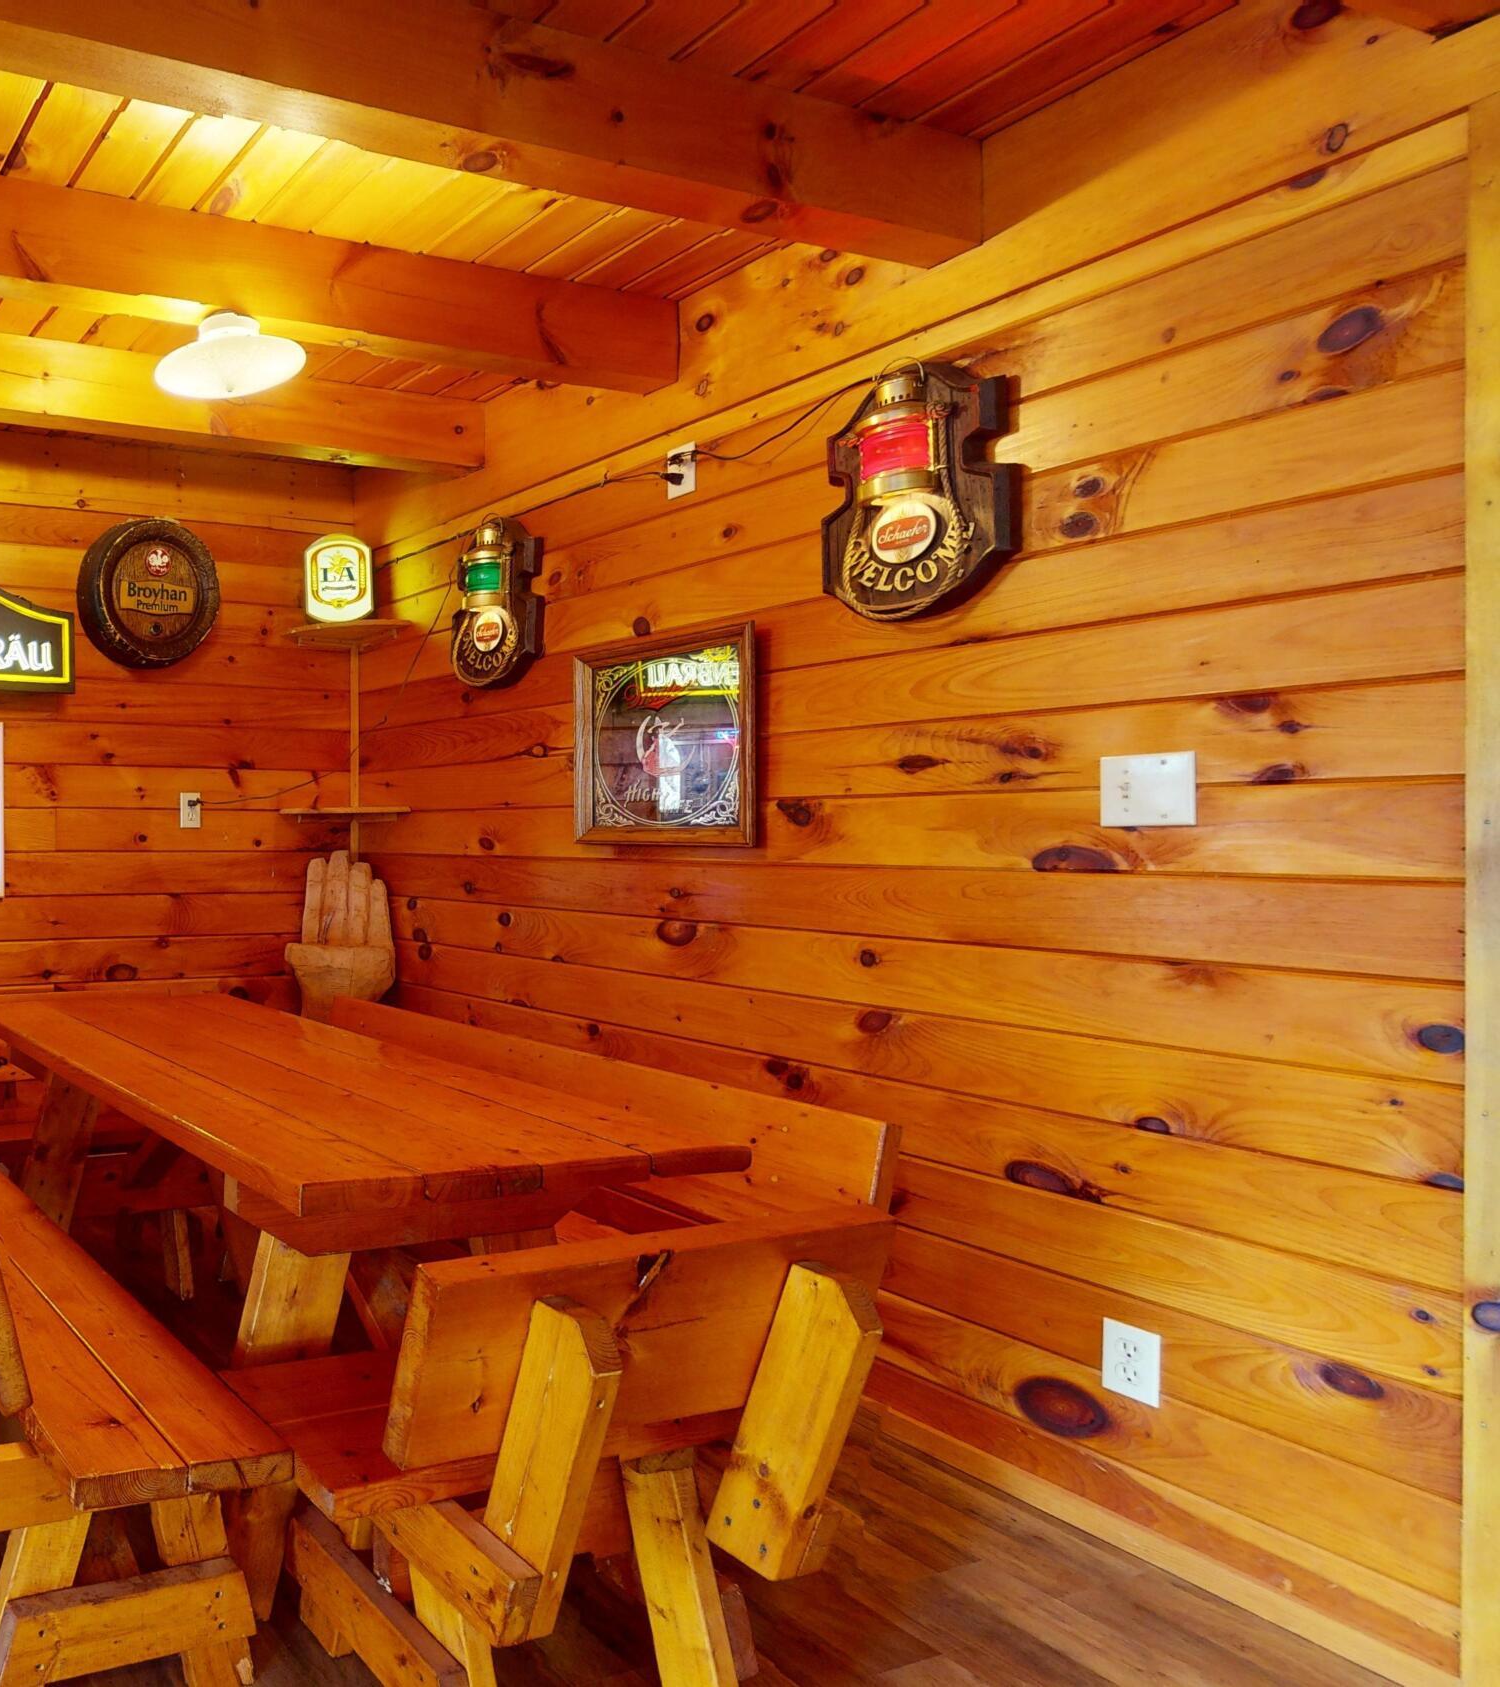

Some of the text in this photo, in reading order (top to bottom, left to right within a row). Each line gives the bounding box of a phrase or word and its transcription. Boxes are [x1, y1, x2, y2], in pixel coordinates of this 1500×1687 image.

[878, 520, 930, 545] Schaefer
[127, 582, 187, 603] Broyhan
[136, 599, 179, 612] Premium
